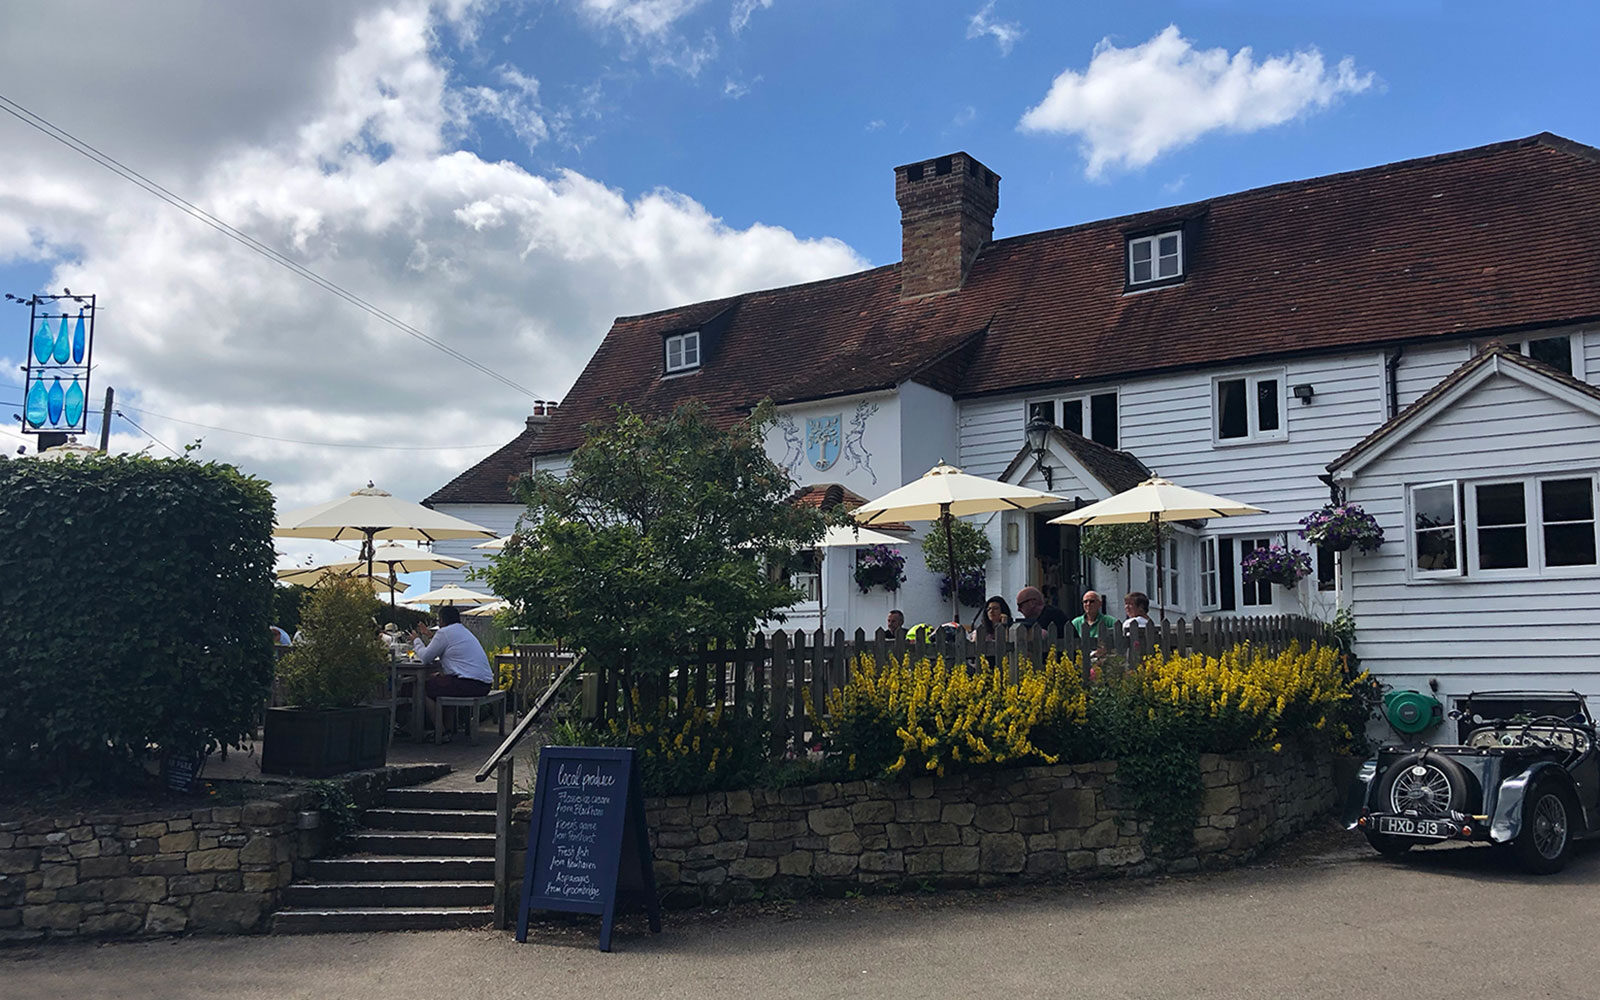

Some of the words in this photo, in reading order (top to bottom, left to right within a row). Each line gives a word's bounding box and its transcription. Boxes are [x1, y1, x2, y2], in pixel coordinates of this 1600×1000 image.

[558, 764, 582, 786] local
[582, 765, 616, 791] produce
[1388, 819, 1415, 833] HXD
[1417, 822, 1438, 835] 513
[549, 855, 565, 870] from
[544, 881, 561, 896] from
[562, 882, 601, 900] Groombridge
